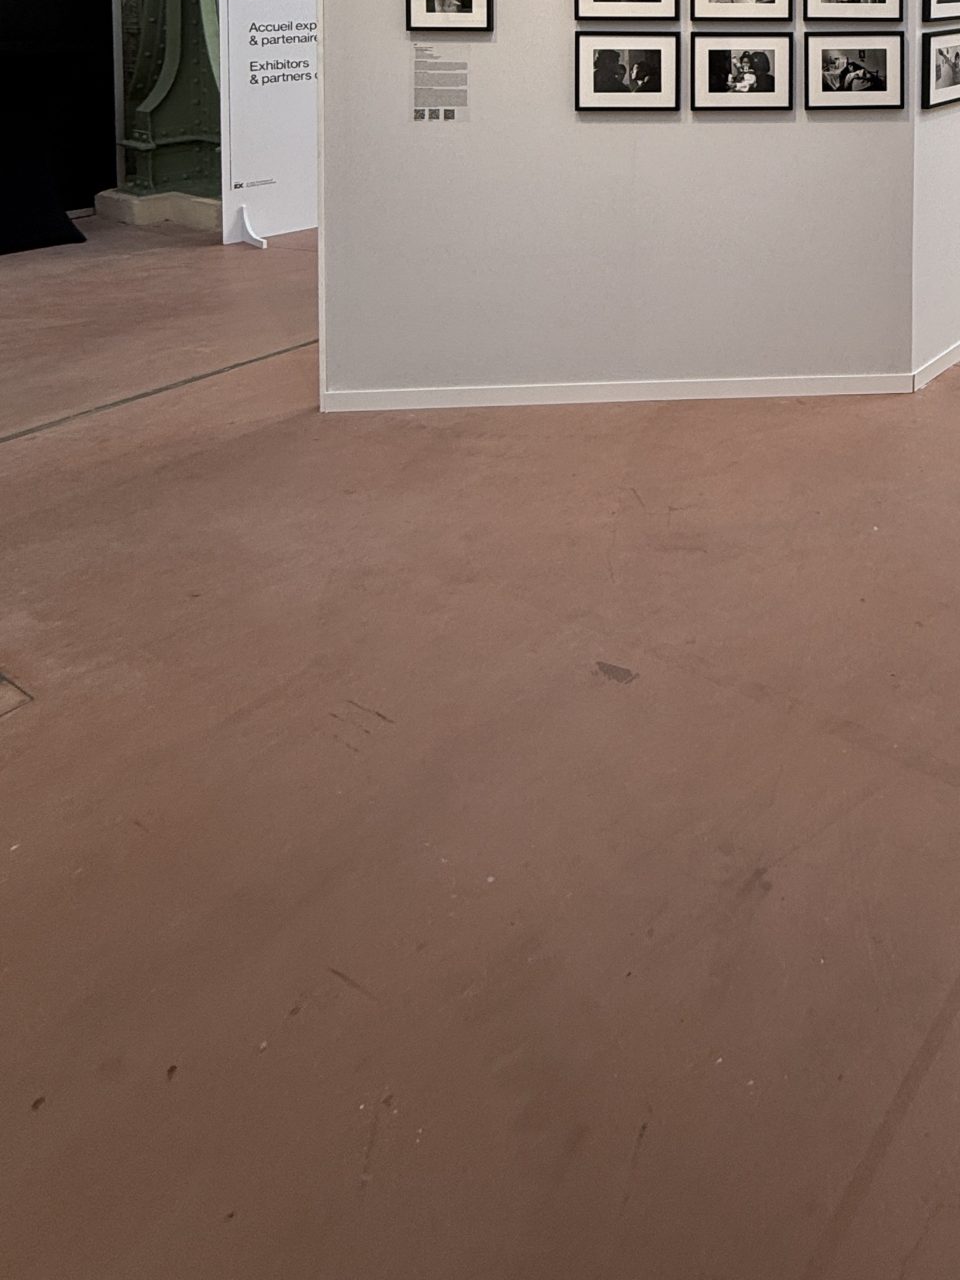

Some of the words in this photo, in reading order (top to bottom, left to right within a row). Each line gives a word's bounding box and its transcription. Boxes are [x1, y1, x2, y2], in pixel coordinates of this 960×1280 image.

[249, 21, 293, 33] Accueil
[249, 35, 258, 46] &
[249, 59, 310, 72] Exhibitors
[250, 74, 259, 85] &
[261, 72, 312, 86] partners
